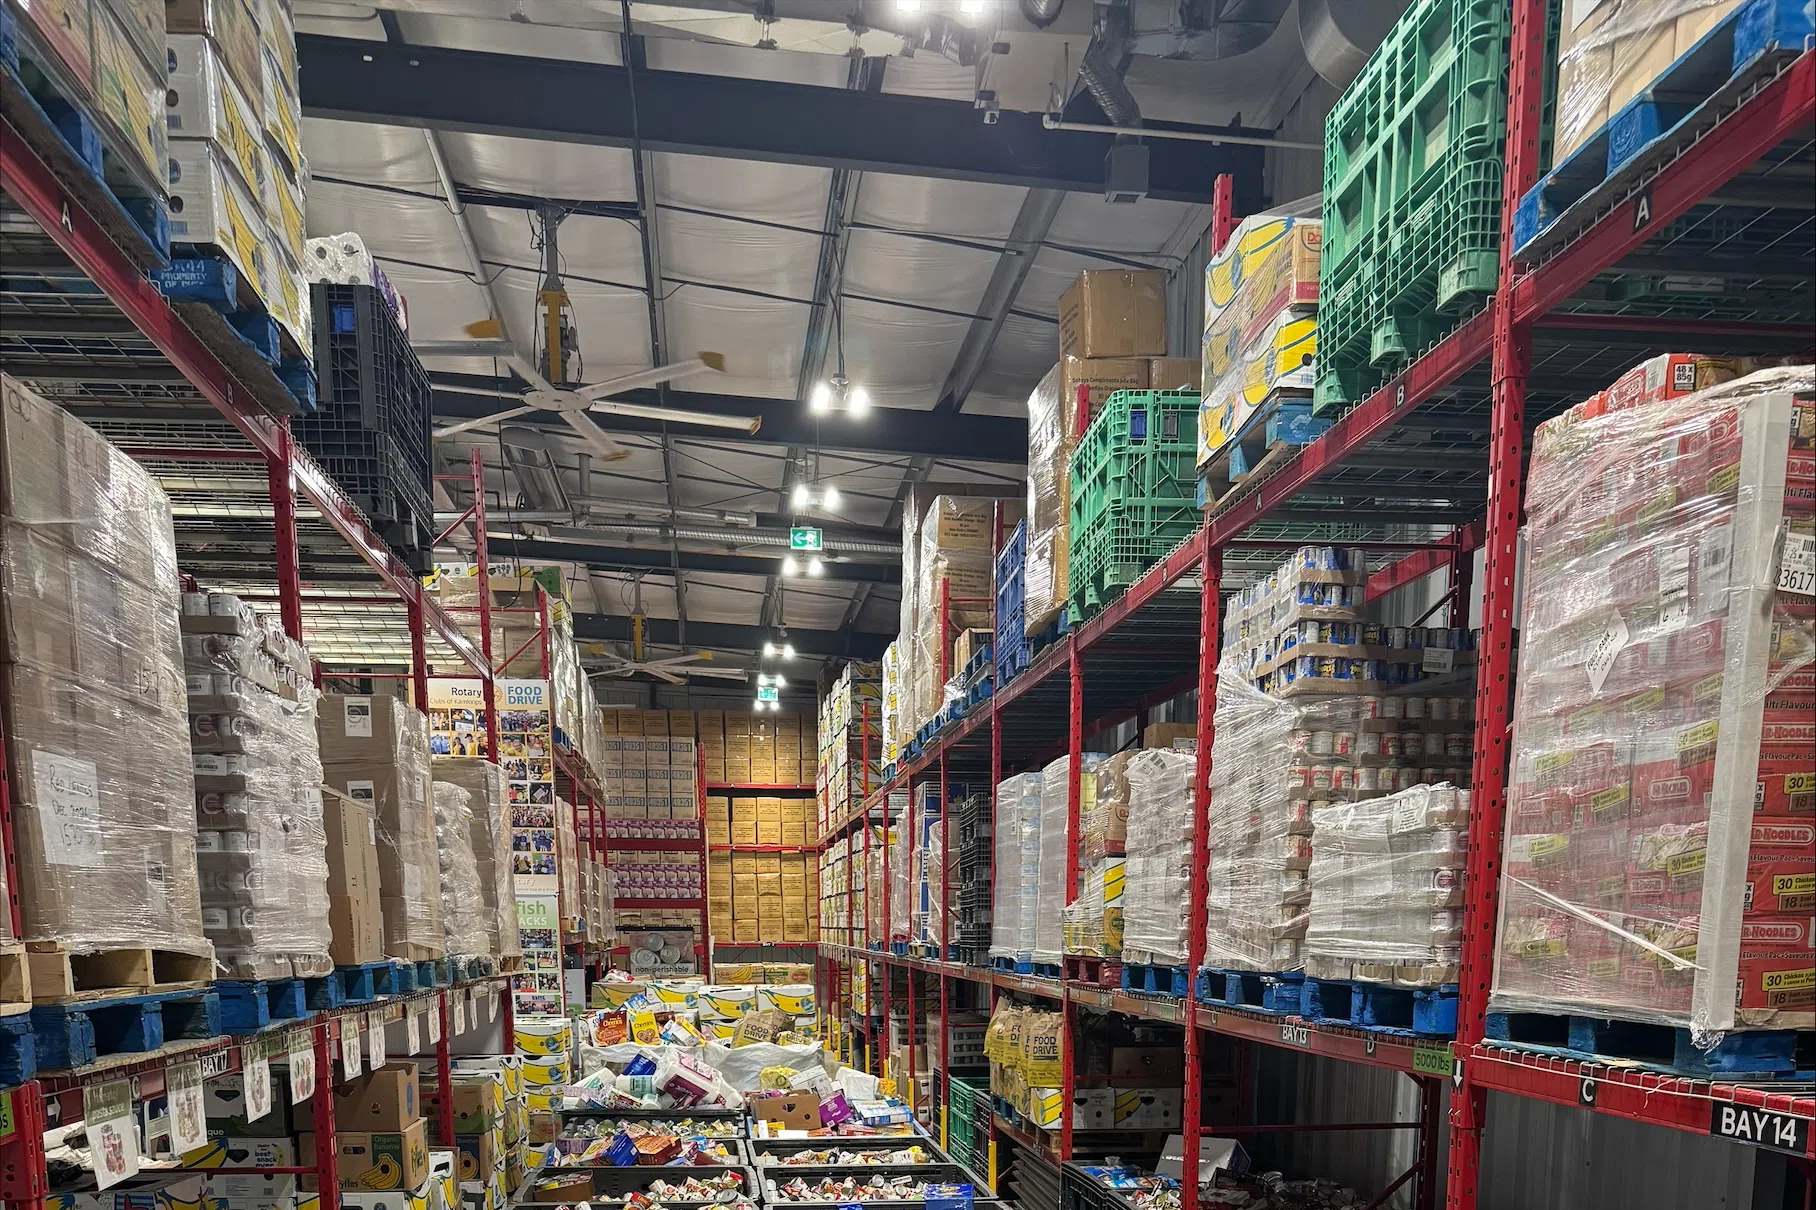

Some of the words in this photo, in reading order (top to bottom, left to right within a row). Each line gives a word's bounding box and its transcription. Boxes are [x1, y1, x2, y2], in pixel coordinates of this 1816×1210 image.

[1635, 195, 1650, 229] A
[61, 206, 74, 233] A
[161, 272, 207, 280] PROPERTY
[1677, 373, 1692, 382] 85g
[1396, 384, 1405, 407] B
[451, 687, 482, 699] Rotary
[507, 686, 542, 696] FOOD
[454, 697, 482, 706] Kamloops
[508, 696, 543, 705] DRIVE
[1788, 776, 1804, 790] 30
[1794, 795, 1808, 808] 18
[1777, 878, 1793, 890] 30
[1784, 897, 1797, 909] 18
[1752, 925, 1797, 939] NOODLES
[635, 966, 689, 975] non-perishable
[1766, 975, 1782, 987] 30
[1773, 992, 1786, 1004] 18
[746, 1022, 769, 1034] FOOD
[744, 1029, 769, 1041] DRIVE
[1034, 1036, 1056, 1045] FOOD
[1282, 1026, 1298, 1042] BAY
[1298, 1029, 1308, 1044] 13
[1033, 1046, 1058, 1055] DRIVE
[1367, 1036, 1375, 1054] D
[203, 1055, 222, 1077] BAY
[1416, 1053, 1437, 1068] 5000
[1437, 1056, 1450, 1071] lbs
[131, 1076, 140, 1098] C
[1582, 1079, 1595, 1102] C
[1721, 1107, 1770, 1142] BAY
[1772, 1116, 1797, 1148] 14
[374, 1135, 400, 1144] Organic
[374, 1143, 400, 1151] Bananas
